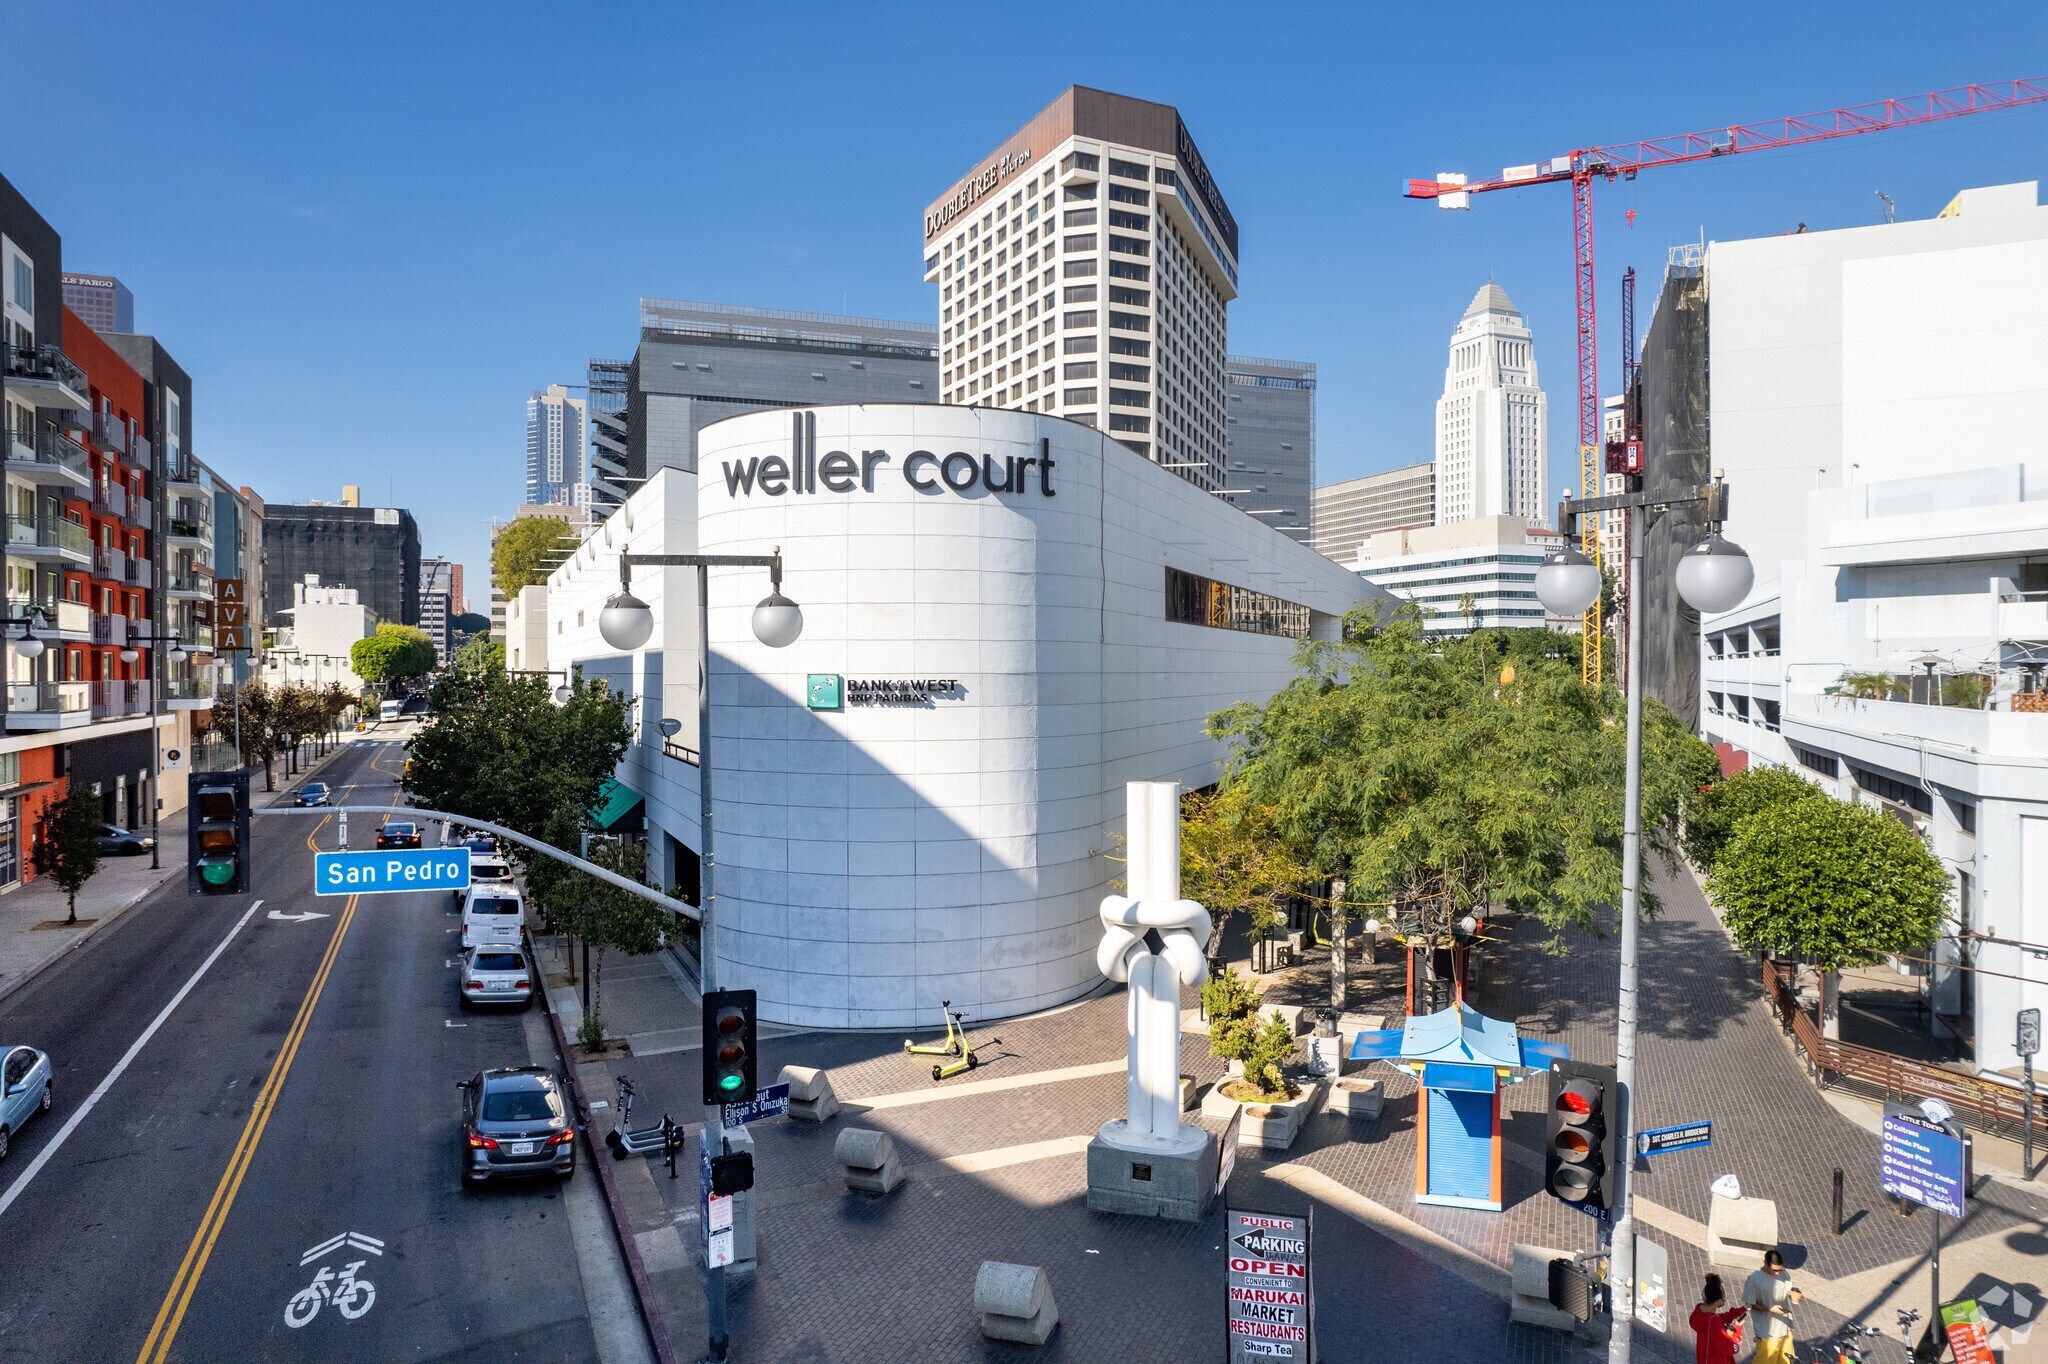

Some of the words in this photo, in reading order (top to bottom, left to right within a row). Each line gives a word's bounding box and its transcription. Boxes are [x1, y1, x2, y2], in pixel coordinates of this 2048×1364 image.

[1001, 152, 1012, 168] BY
[1001, 149, 1031, 179] HILTON
[79, 278, 113, 288] FARGO
[722, 410, 886, 499] weller
[903, 437, 1056, 497] court
[224, 583, 236, 647] AVA
[848, 680, 892, 692] BANK
[911, 680, 958, 692] WEST
[848, 694, 872, 703] BNP
[876, 694, 928, 703] PARIBAS
[328, 862, 376, 884] San
[387, 860, 460, 882] Pedro
[725, 1106, 750, 1120] Ellison
[752, 1102, 758, 1114] S
[760, 1096, 788, 1112] Onizuka
[782, 1106, 788, 1114] St
[726, 1118, 736, 1127] 100
[1894, 1124, 1920, 1138] Caltrans
[1652, 1135, 1661, 1144] SGT.
[1661, 1131, 1680, 1142] CHARLES
[1893, 1135, 1912, 1148] Honda
[1913, 1142, 1930, 1154] Plaza
[1893, 1146, 1914, 1160] Village
[1915, 1154, 1932, 1166] Plaza
[1892, 1158, 1912, 1170] Koban
[1912, 1164, 1934, 1178] Visitor
[1935, 1173, 1957, 1186] Center
[1892, 1169, 1910, 1181] Union
[1911, 1176, 1922, 1184] Ctr
[1922, 1180, 1933, 1189] for
[1934, 1184, 1949, 1195] Arts
[1584, 1203, 1598, 1216] 200
[1601, 1210, 1605, 1220] E
[1240, 1216, 1293, 1230] PUBLIC
[1244, 1235, 1305, 1254] PARKING
[1230, 1258, 1304, 1278] OPEN
[1245, 1277, 1282, 1287] CONVENIENT
[1230, 1288, 1305, 1306] MARUKAI
[1241, 1302, 1294, 1324] MARKET
[1230, 1320, 1305, 1341] RESTAURANTS
[1244, 1340, 1272, 1355] Sharp
[1274, 1344, 1292, 1355] Tea
